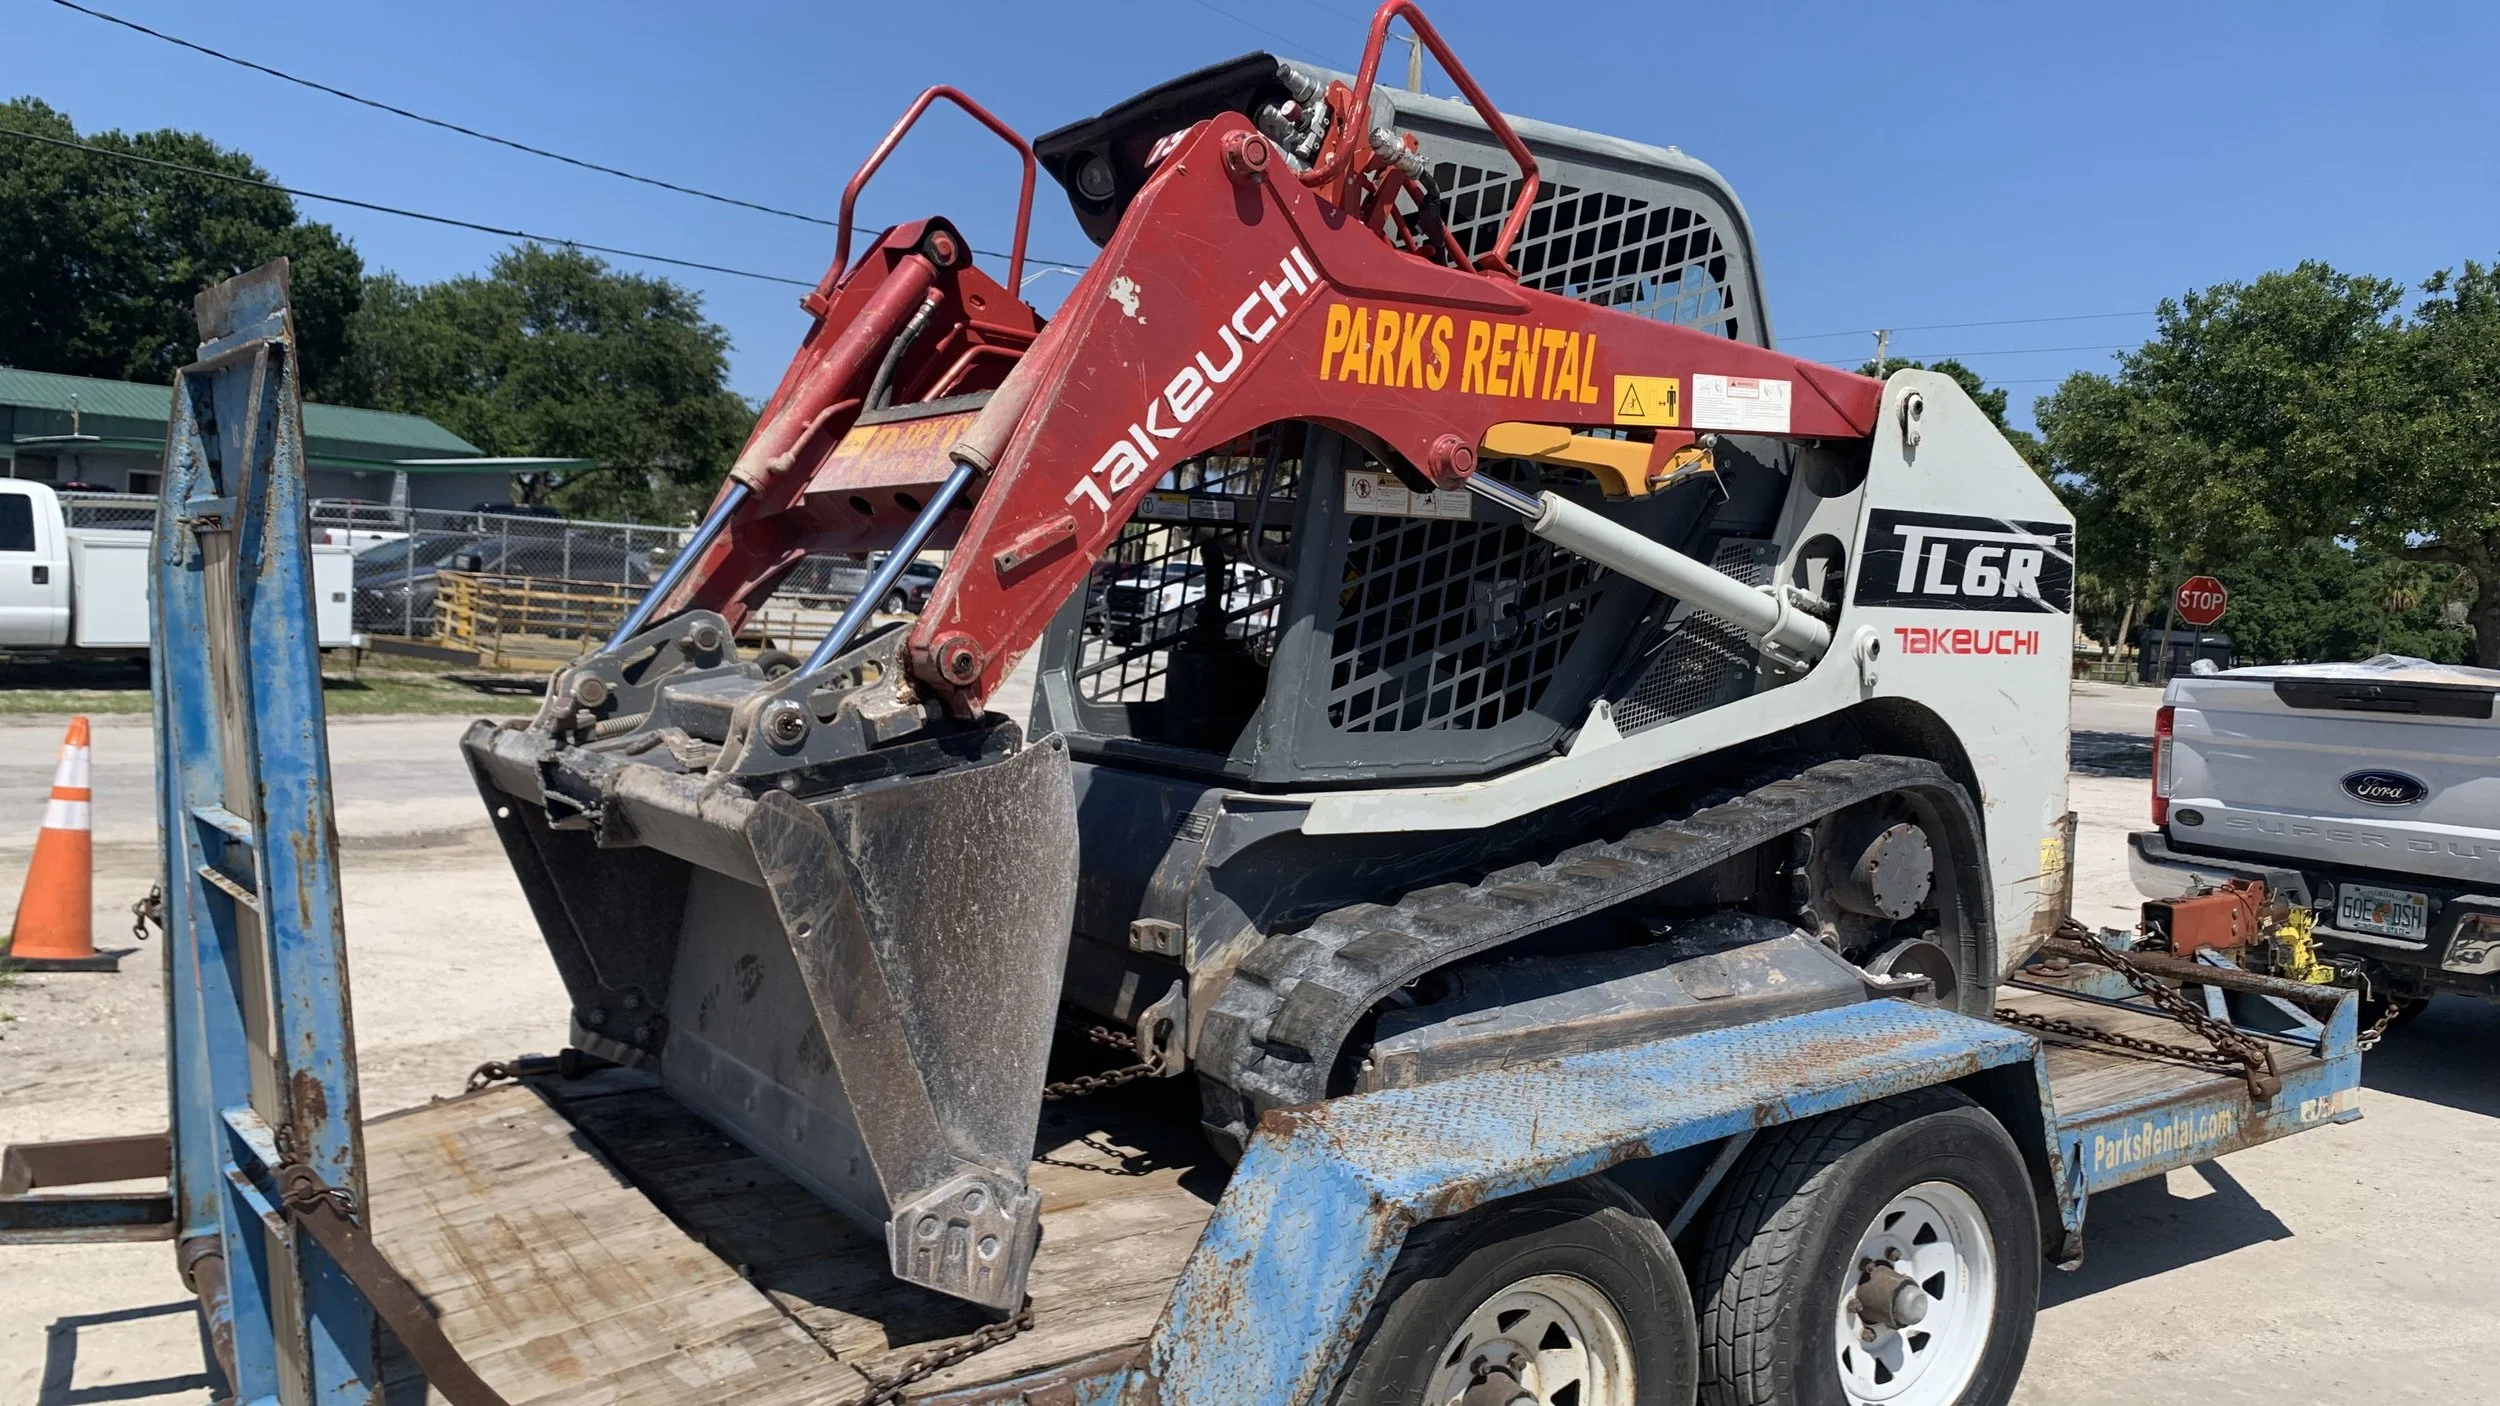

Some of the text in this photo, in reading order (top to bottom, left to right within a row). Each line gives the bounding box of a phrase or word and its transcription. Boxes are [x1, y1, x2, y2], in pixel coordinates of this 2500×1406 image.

[1320, 303, 1599, 404] PARKS RENTAL
[1893, 525, 2056, 599] TL6R
[2179, 590, 2224, 611] STOP
[2357, 775, 2404, 798] Ford
[2224, 816, 2392, 849] SUPER
[2094, 1108, 2231, 1172] ParksRental.com
